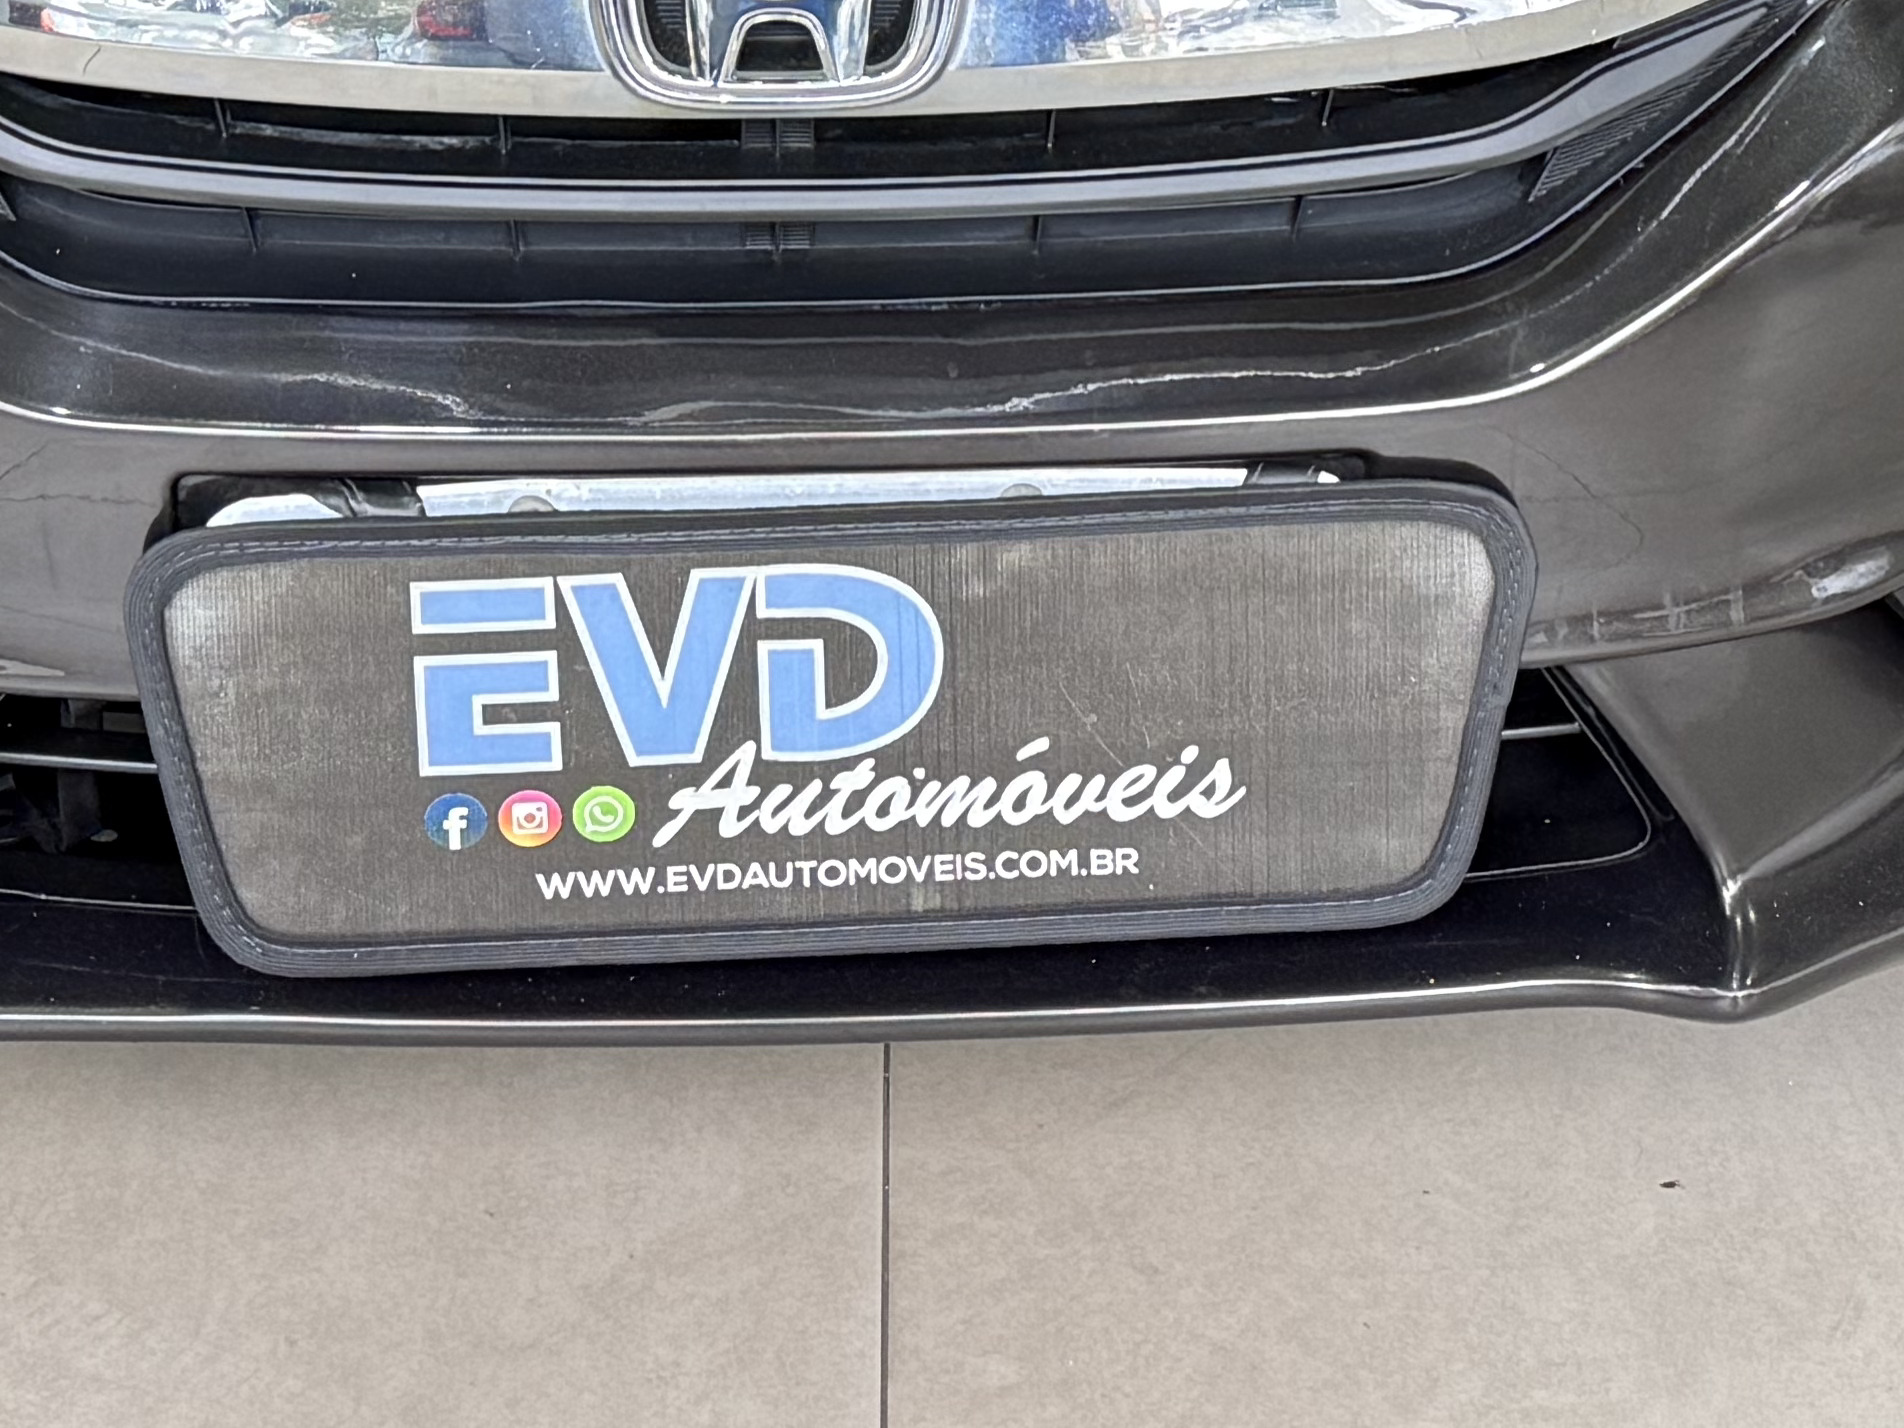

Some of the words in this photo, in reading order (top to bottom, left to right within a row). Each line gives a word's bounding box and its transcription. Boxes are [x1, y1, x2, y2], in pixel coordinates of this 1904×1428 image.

[410, 563, 944, 776] EVD
[652, 737, 1246, 848] Automóveis
[535, 847, 1141, 901] WWW.EVDAUTOMOVEIS.COM.BR
